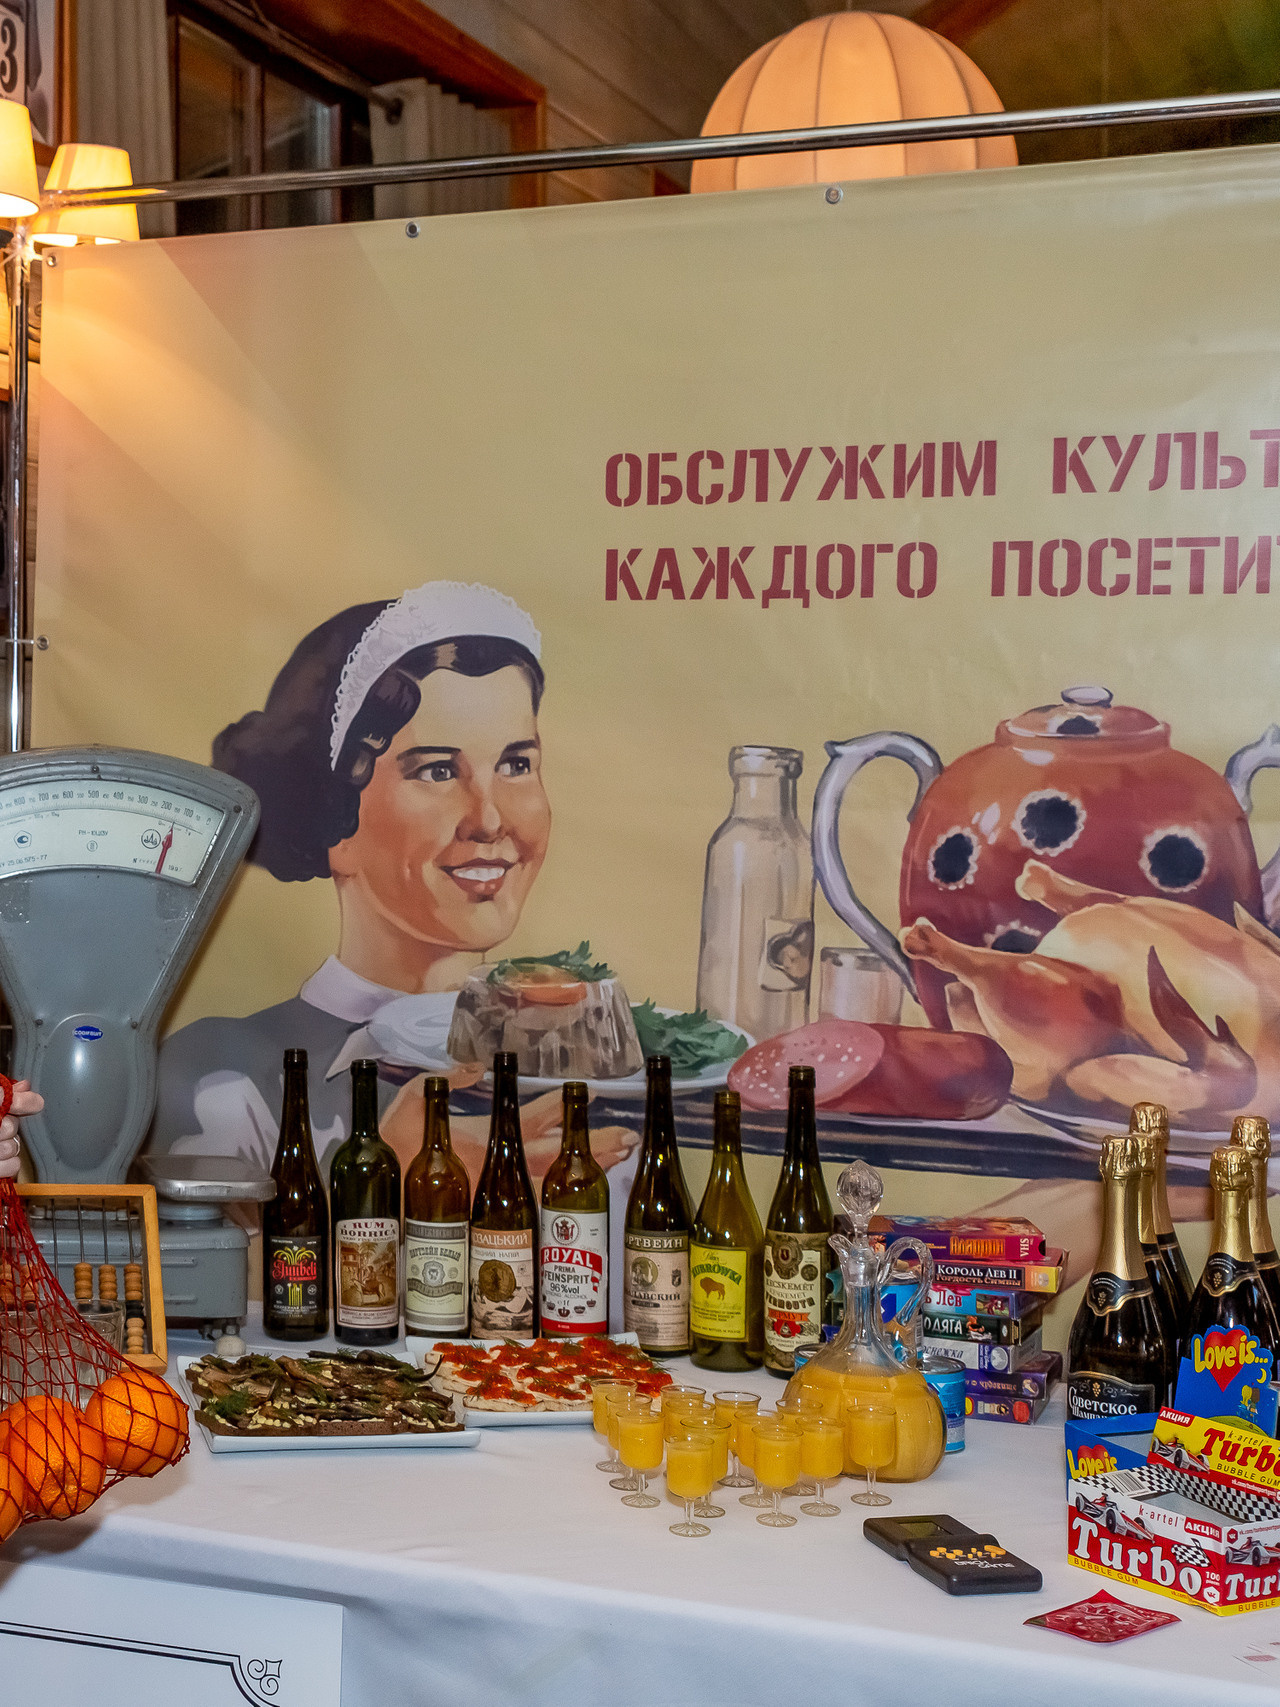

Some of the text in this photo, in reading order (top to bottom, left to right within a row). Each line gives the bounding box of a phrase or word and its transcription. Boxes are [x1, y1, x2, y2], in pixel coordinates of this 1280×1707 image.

[604, 440, 997, 508] ОБСЛУЖИМ
[605, 535, 1280, 609] КАЖДОГО ПОСЕТИ
[87, 790, 100, 798] 500
[112, 791, 124, 800] 400
[137, 794, 149, 805] 300
[160, 800, 173, 811] 200
[183, 807, 194, 818] 100
[340, 1229, 396, 1238] BORRICA
[472, 1232, 528, 1246] ОЗАЦЬКИЙ
[1019, 1237, 1030, 1257] VHS
[543, 1247, 593, 1268] ROYAL
[544, 1270, 590, 1284] FEINSPRIT
[553, 1265, 576, 1273] PRIMA
[936, 1290, 963, 1307] Лев
[923, 1316, 963, 1335] ОДЯГА
[922, 1345, 964, 1360] оснежка
[1194, 1338, 1237, 1373] Love
[1068, 1386, 1138, 1415] Советское
[1160, 1410, 1191, 1425] АКЦИЯ
[1067, 1449, 1105, 1479] Love
[1216, 1463, 1280, 1487] BUBBLE GUM
[1185, 1521, 1220, 1539] АКЦИЯ
[1072, 1516, 1202, 1596] Turbo
[1074, 1557, 1139, 1585] BUBBLE GUM
[1205, 1571, 1220, 1581] 100
[1225, 1567, 1280, 1601] Tur
[1238, 1599, 1276, 1612] BUBBLE
